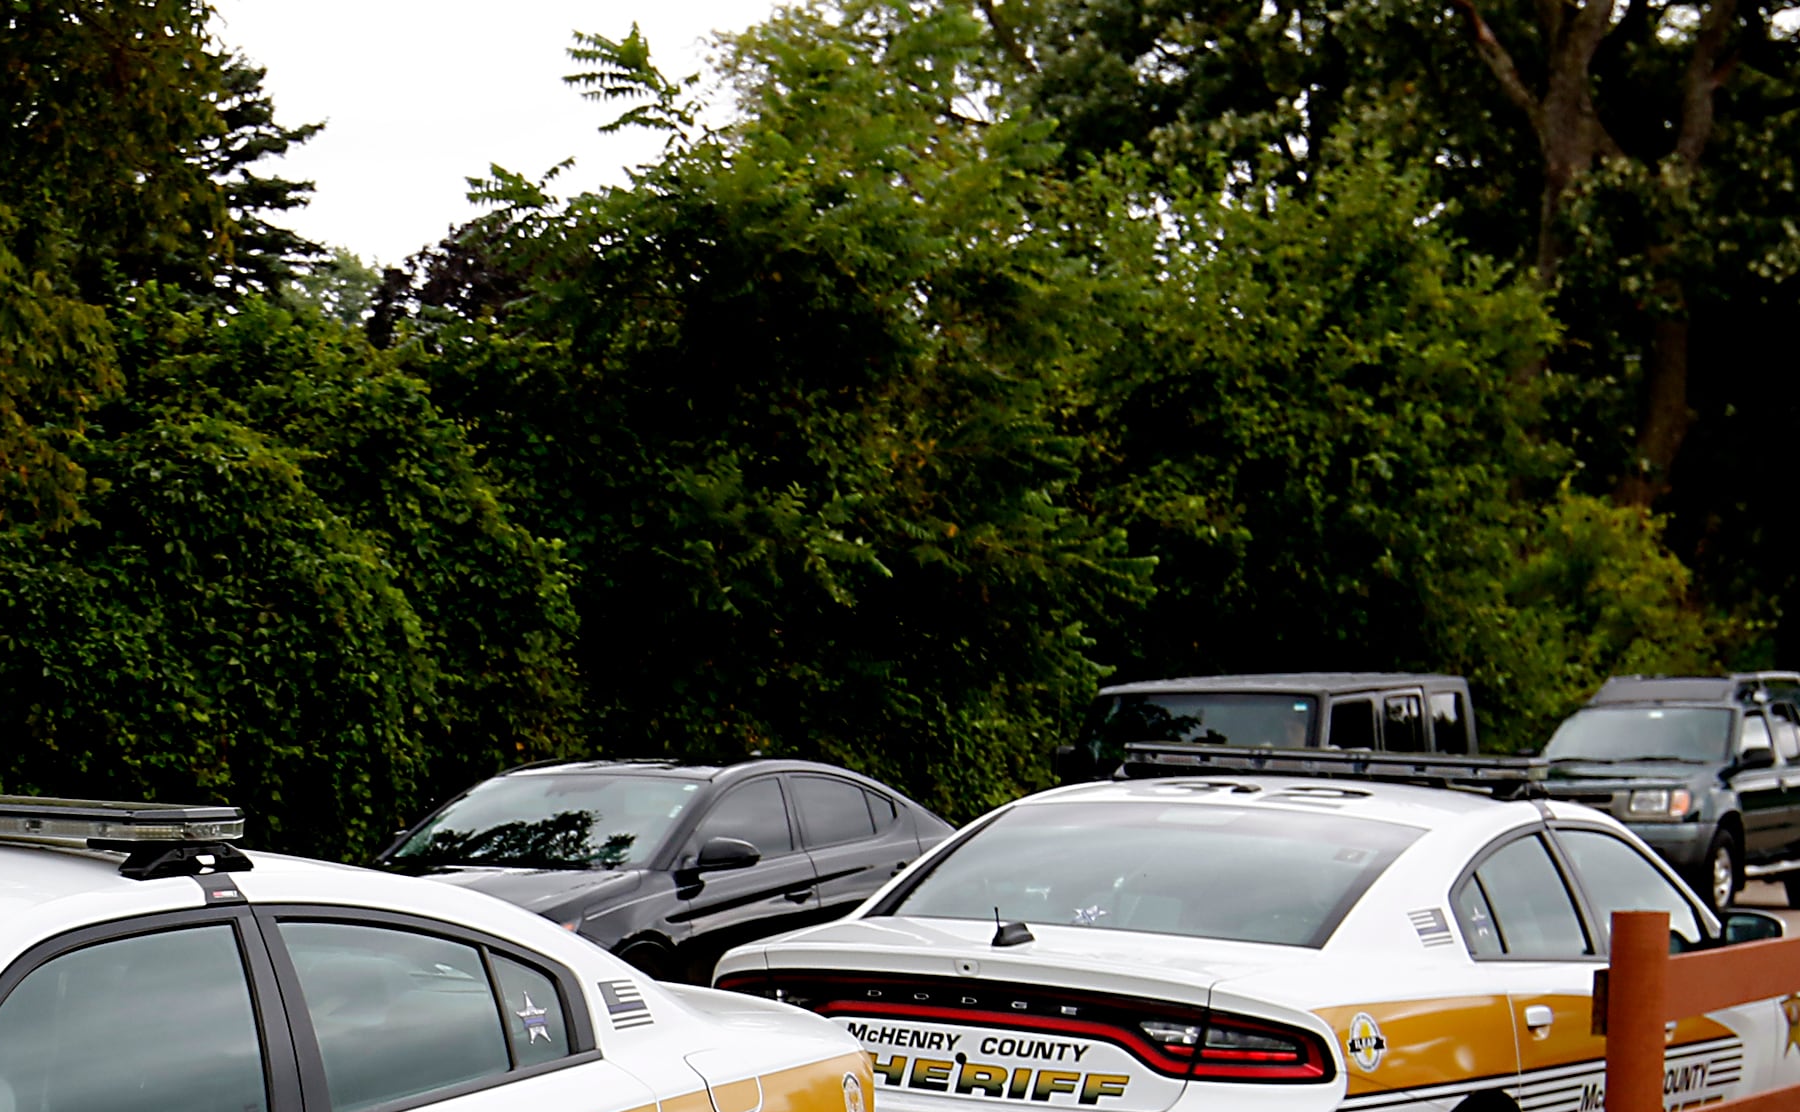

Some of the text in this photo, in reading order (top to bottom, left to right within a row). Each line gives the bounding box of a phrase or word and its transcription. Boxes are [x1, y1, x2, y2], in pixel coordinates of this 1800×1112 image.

[866, 989, 1078, 1015] DODGE
[847, 1022, 1089, 1062] McHENRY COUNTY
[867, 1052, 1131, 1106] HERIFF
[1663, 1063, 1710, 1095] OUNTY
